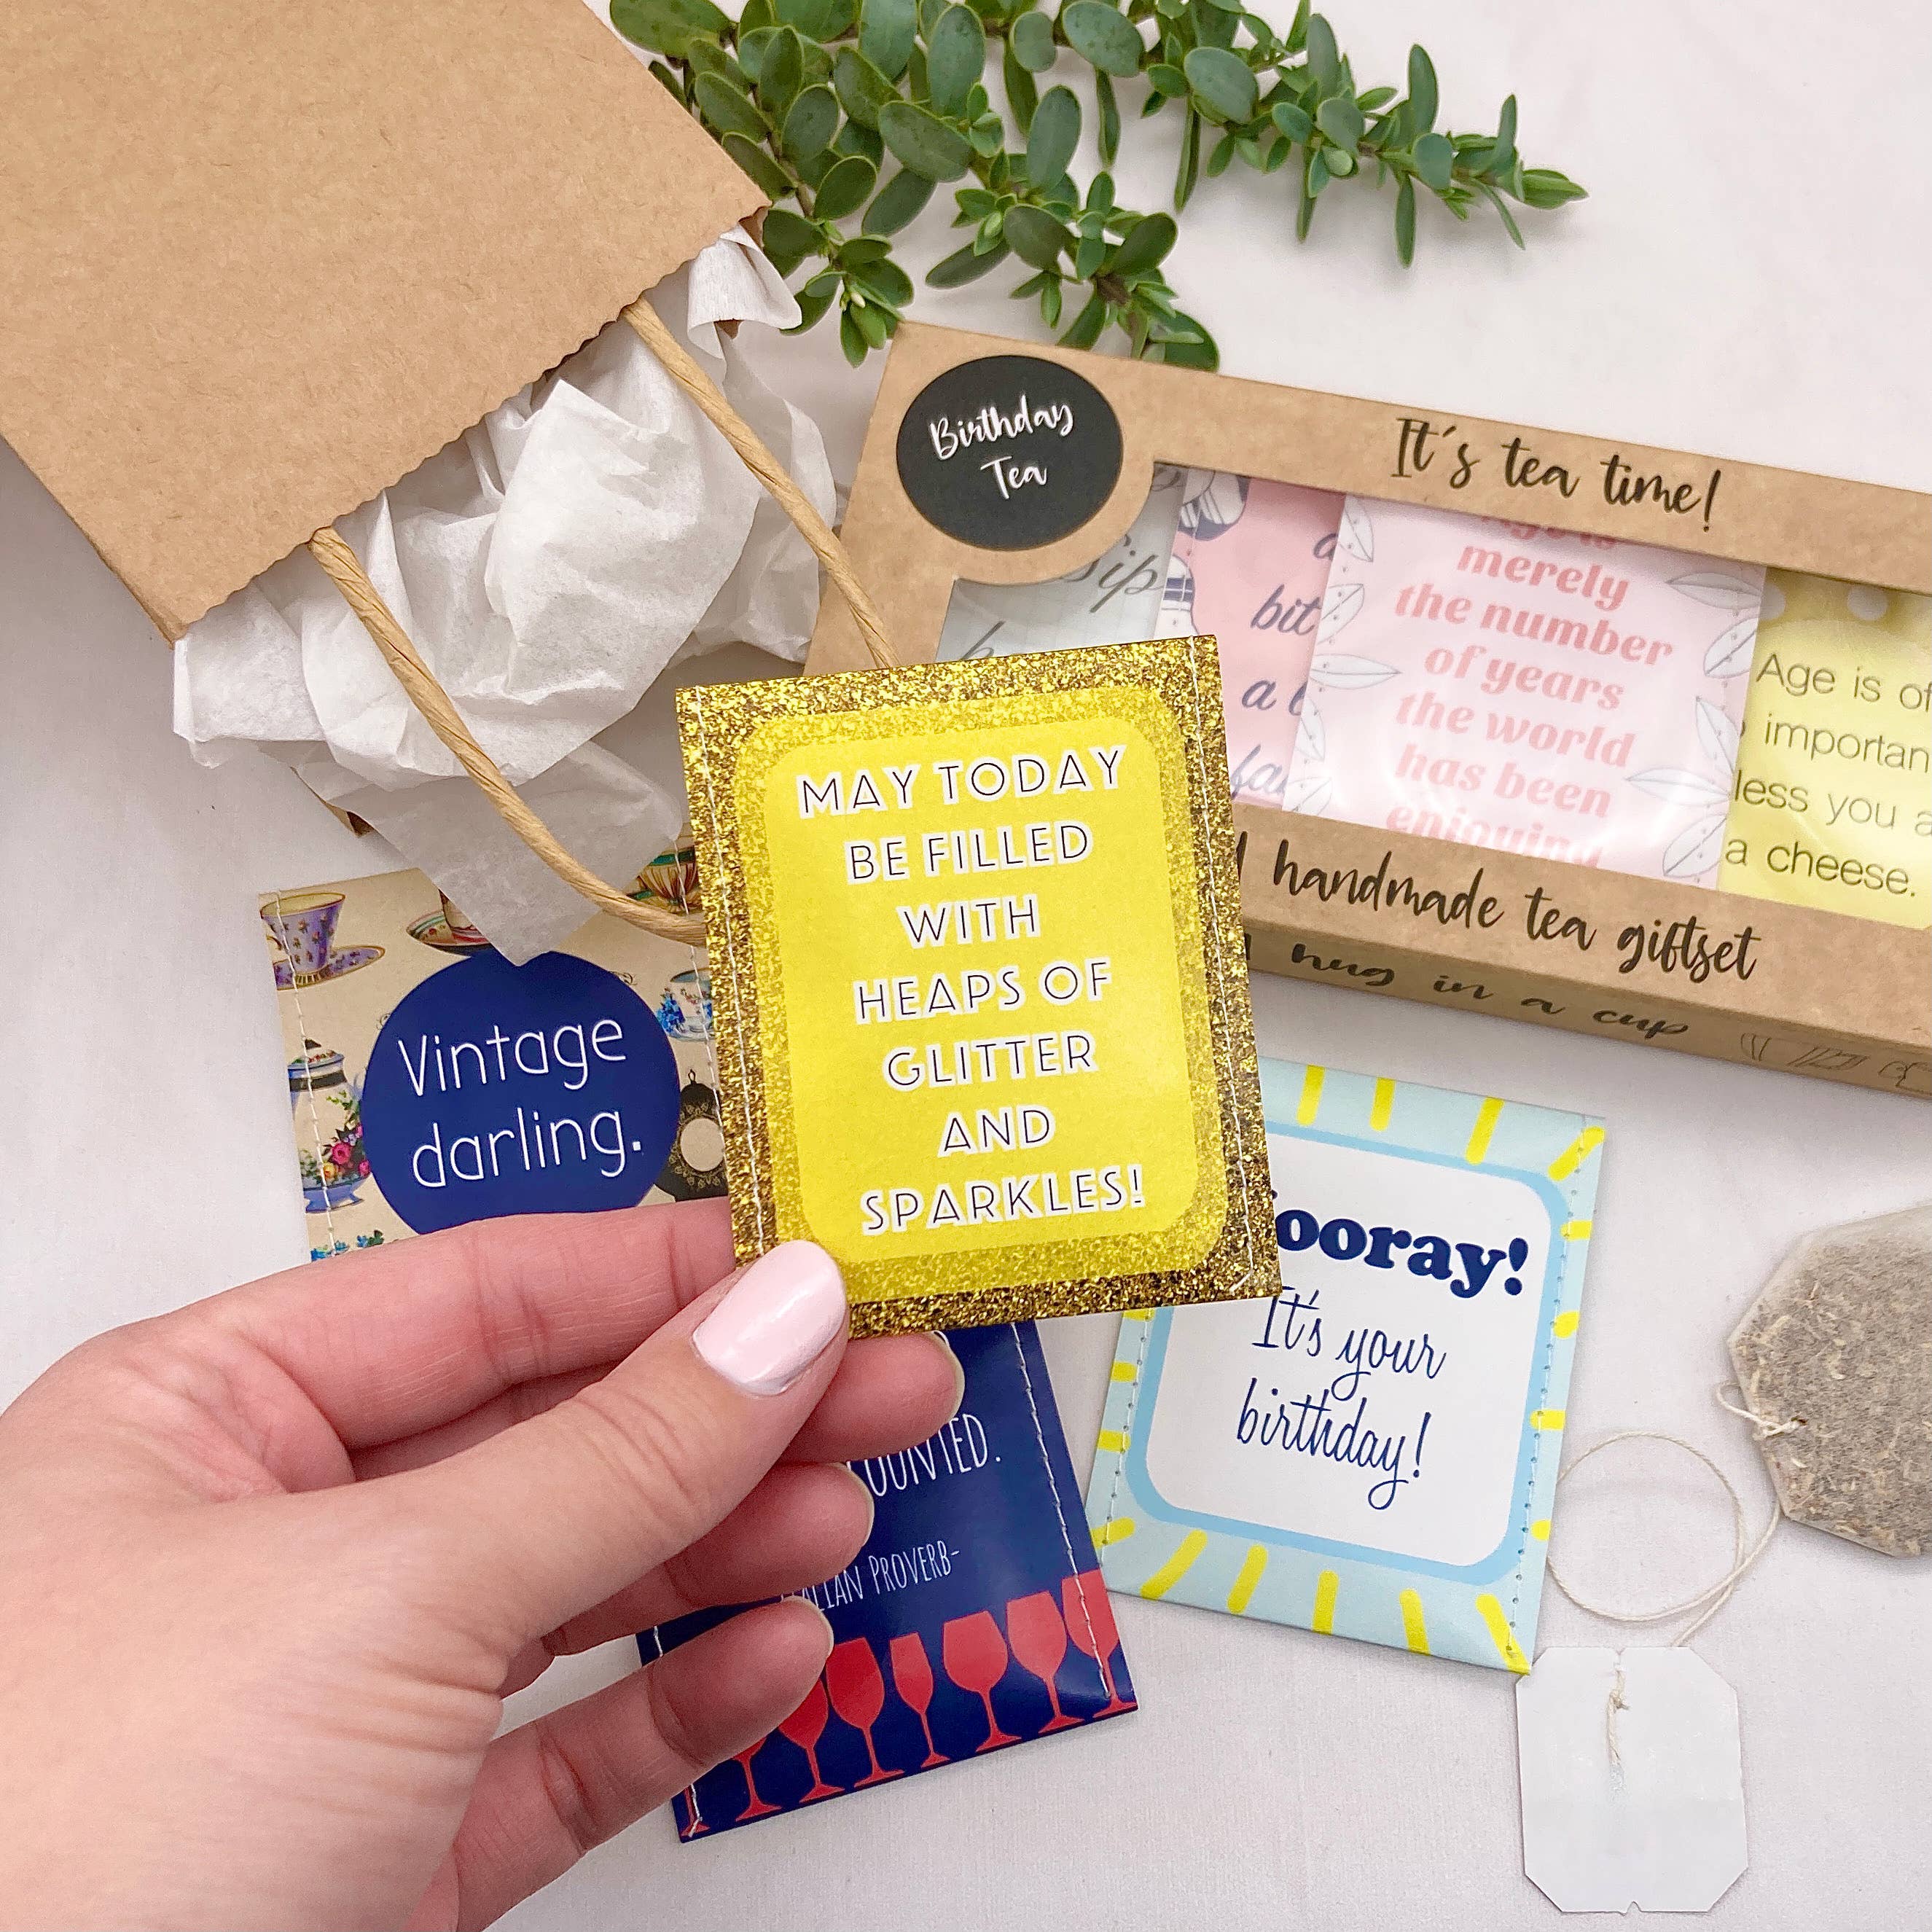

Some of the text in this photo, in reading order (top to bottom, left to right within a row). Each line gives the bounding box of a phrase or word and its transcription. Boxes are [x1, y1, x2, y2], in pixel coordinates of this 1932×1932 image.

[929, 390, 1074, 461] Birthday
[980, 455, 1047, 500] Tea
[1391, 417, 1479, 489] It's
[1501, 437, 1581, 498] tea
[1600, 453, 1722, 533] time!
[1455, 541, 1630, 614] merely
[1393, 582, 1674, 666] the number
[1242, 678, 1277, 713] a
[1423, 644, 1625, 713] of years
[1756, 653, 1836, 697] Age
[1853, 666, 1881, 703] is
[1394, 692, 1638, 770] the world
[796, 743, 1128, 821] MAY TODAY
[1396, 743, 1613, 818] has been
[1735, 770, 1809, 813] less
[1826, 792, 1896, 830] you
[845, 820, 1092, 885] BE FILLED
[1725, 839, 1917, 898] a cheese.
[896, 893, 1041, 951] WITH
[1274, 839, 1505, 928] handmade
[1524, 886, 1597, 951] tea
[1616, 917, 1762, 982] giftset
[853, 957, 1114, 1026] HEAPS OF
[1291, 942, 1689, 1040] hug in a cup
[397, 1017, 627, 1098] Vintage
[882, 1031, 1098, 1093] GLITTER
[412, 1105, 642, 1189] darling.
[937, 1105, 1056, 1157] AND
[859, 1163, 1146, 1238] SPARKLES!
[1272, 1189, 1530, 1299] ooray!
[1251, 1285, 1447, 1401] It's your
[1237, 1377, 1432, 1511] birthday!
